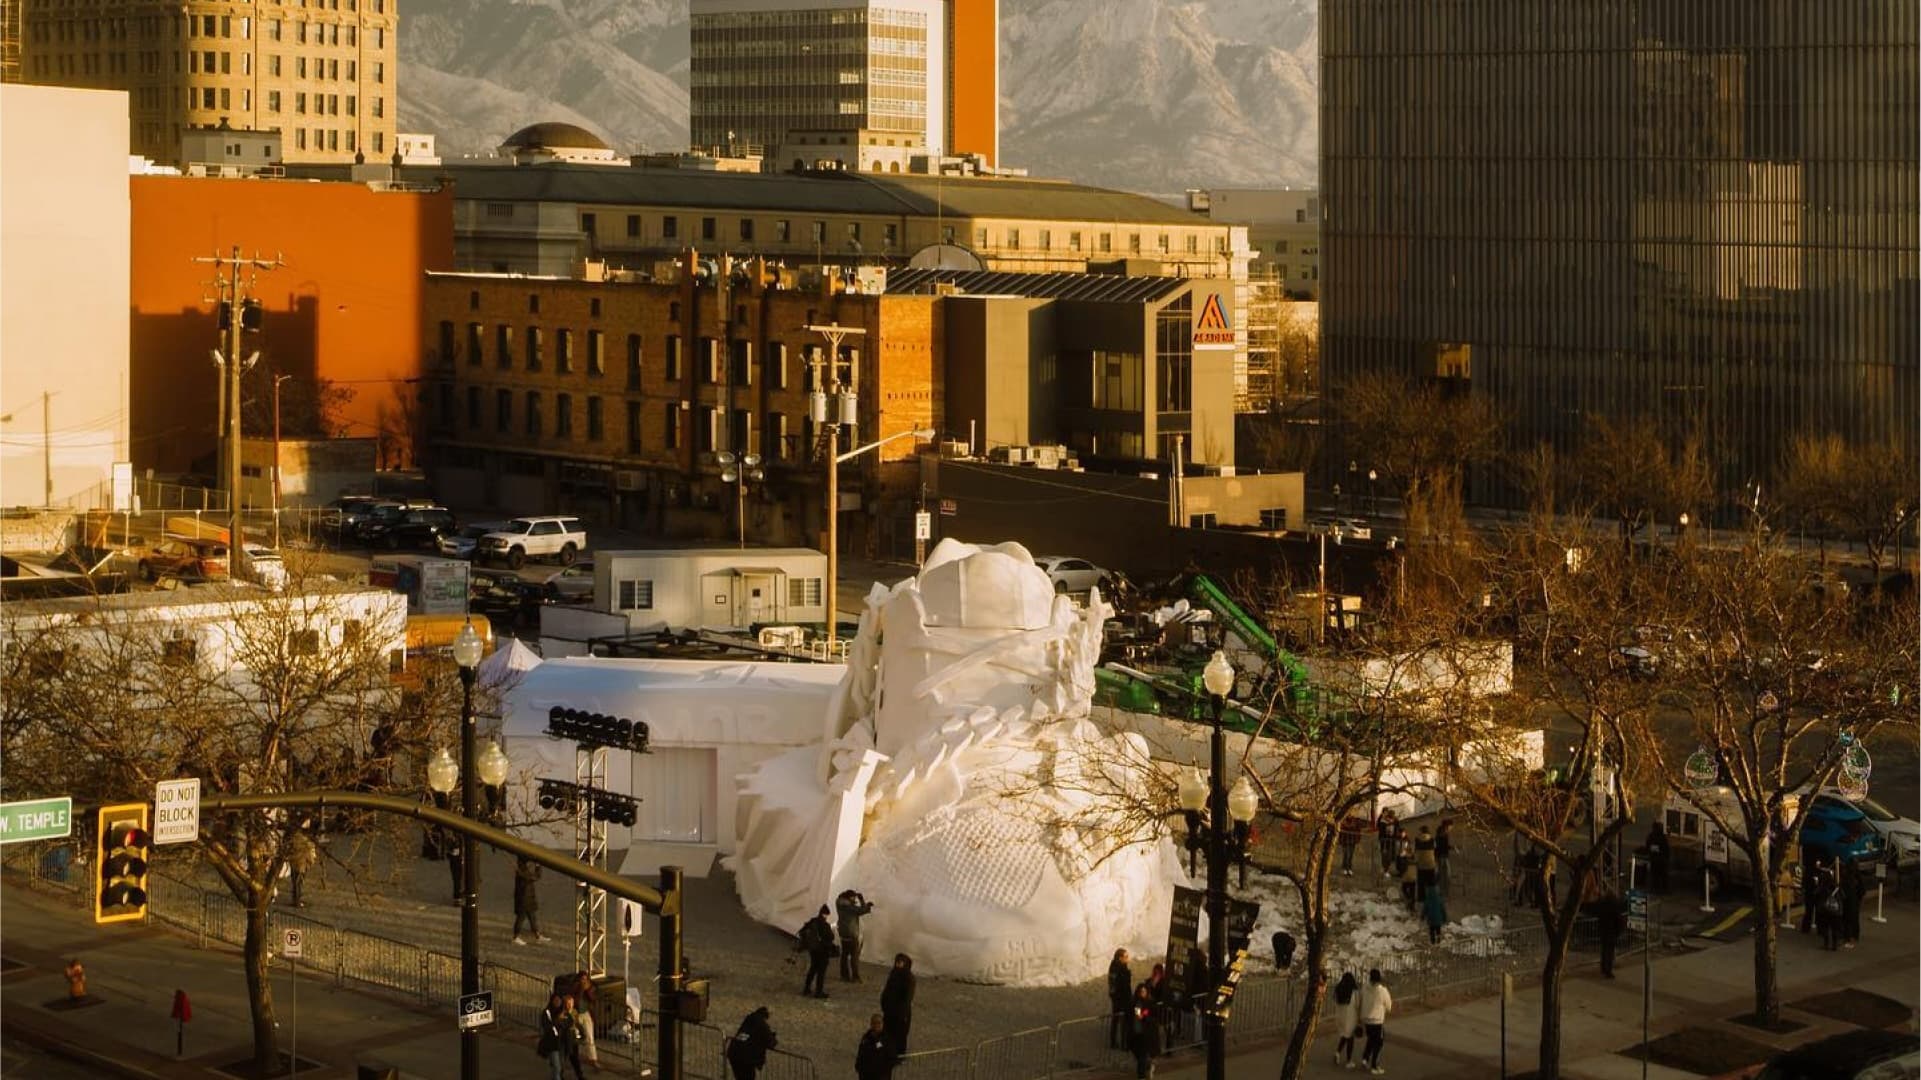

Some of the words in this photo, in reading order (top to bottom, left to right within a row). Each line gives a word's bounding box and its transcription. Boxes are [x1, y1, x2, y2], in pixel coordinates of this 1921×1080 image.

[160, 789, 173, 803] DO
[177, 786, 195, 802] NOT
[18, 810, 66, 831] TEMPLE
[159, 807, 195, 823] BLOCK
